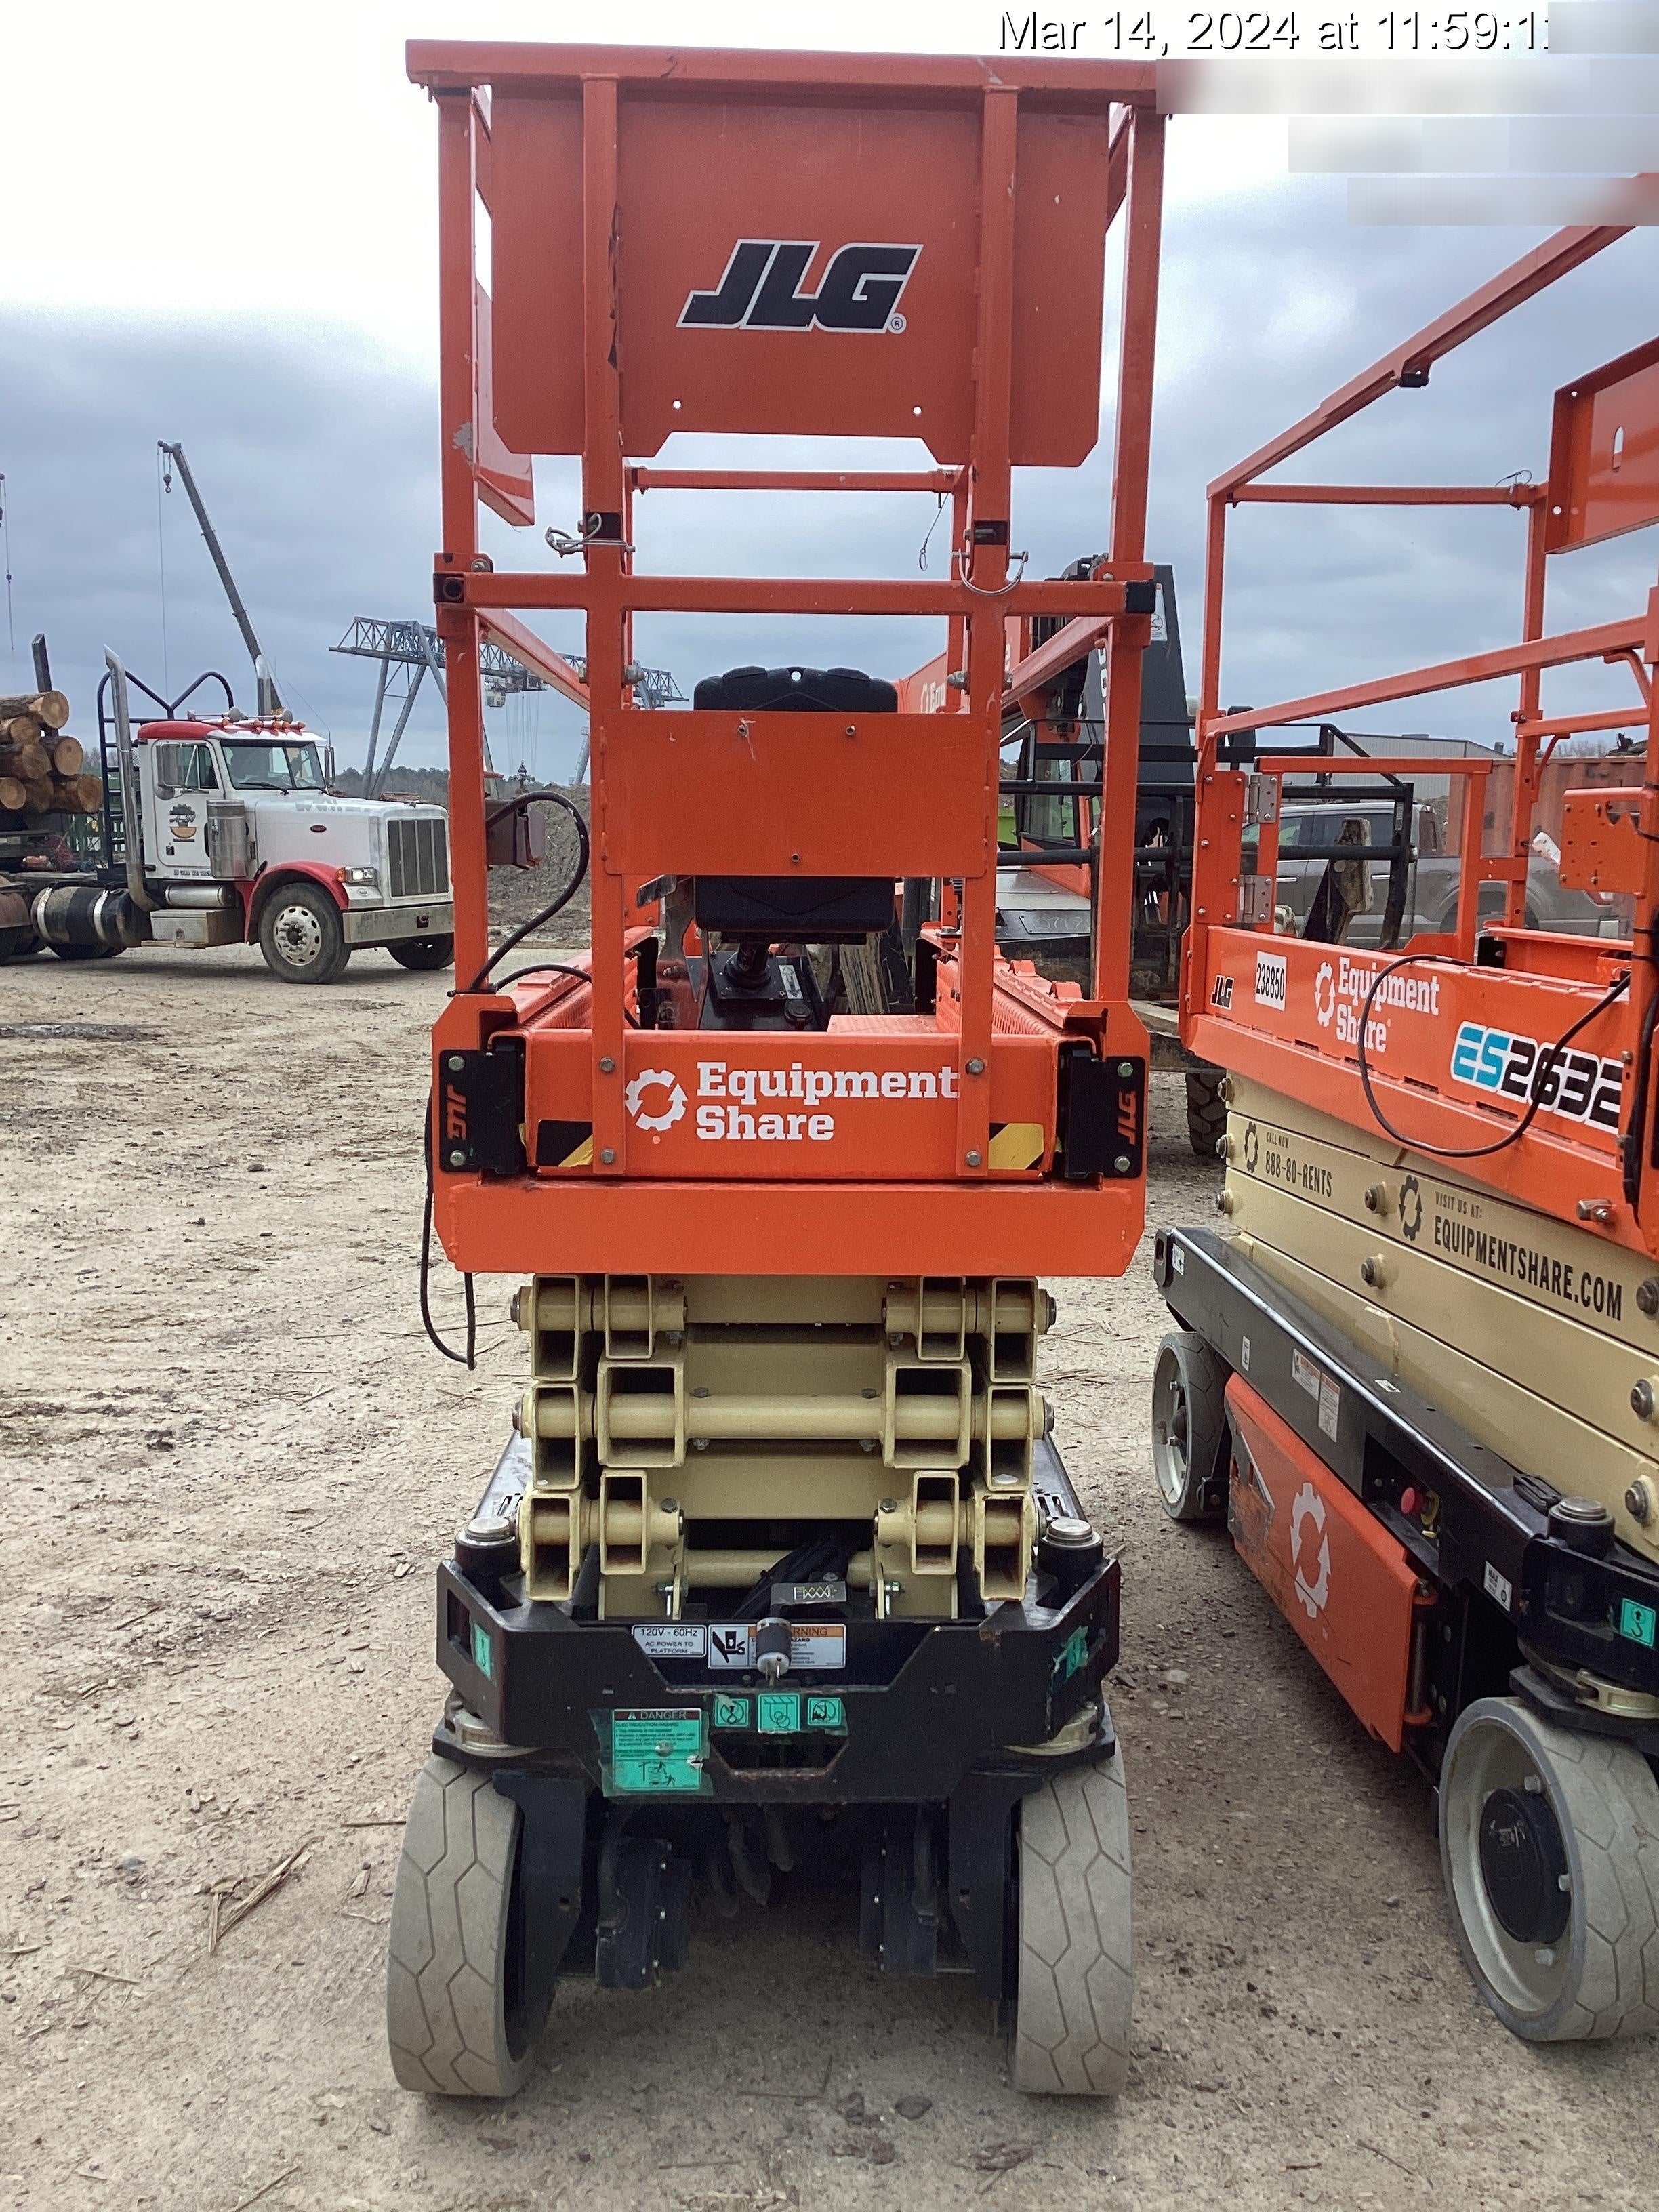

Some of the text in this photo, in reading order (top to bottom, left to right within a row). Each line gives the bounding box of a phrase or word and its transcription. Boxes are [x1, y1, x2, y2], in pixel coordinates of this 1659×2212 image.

[1210, 975, 1235, 1010] JLG
[1256, 962, 1285, 1002] 238850
[1338, 956, 1440, 1016] Equipment
[696, 1061, 961, 1106] Equipment
[1450, 1020, 1624, 1135] ES2632
[447, 1084, 467, 1140] JLG
[695, 1105, 834, 1141] Share
[1118, 1090, 1136, 1147] JLG
[1265, 1132, 1277, 1145] CALL
[1265, 1150, 1332, 1197] 888-80-RENTS
[1435, 1191, 1483, 1219] VISIT US AT:
[1434, 1215, 1622, 1322] EQUIPMENTSHARE.COM
[641, 1627, 665, 1637] 120V
[673, 1627, 698, 1637] 60Hz
[791, 1627, 828, 1637] RNING
[640, 1711, 687, 1719] DANGER
